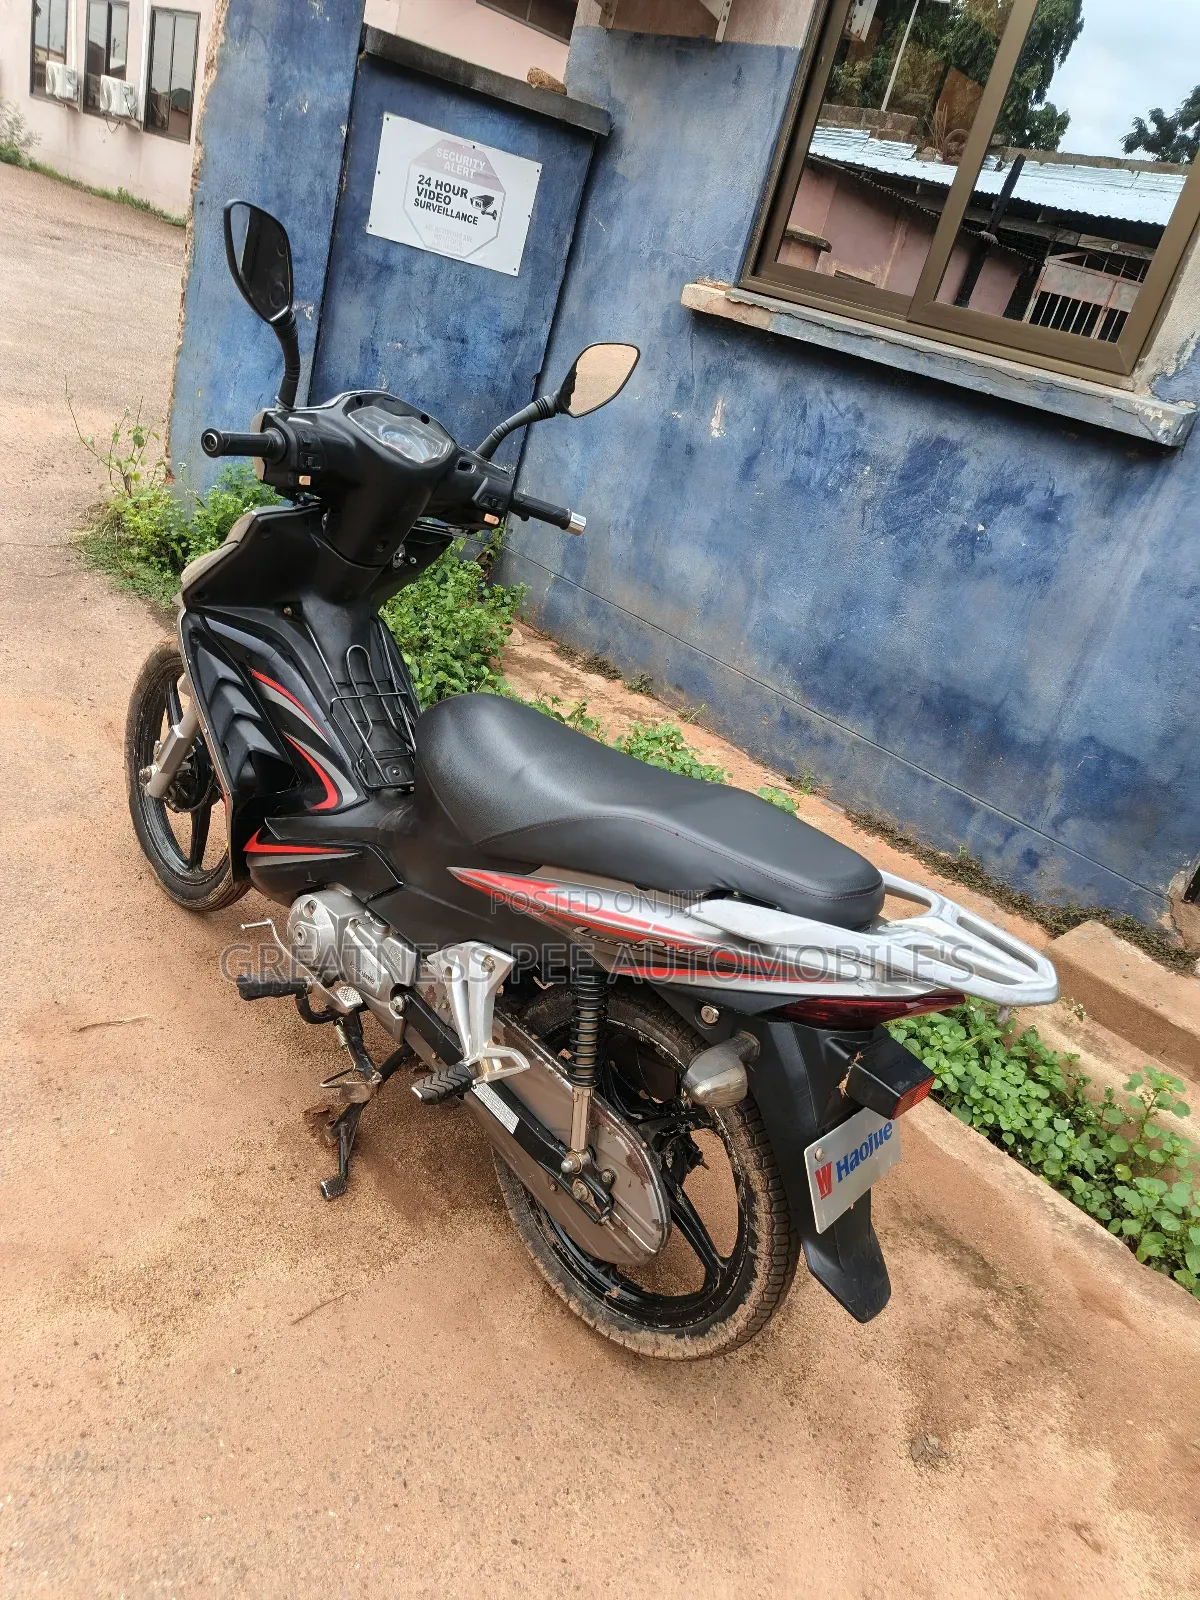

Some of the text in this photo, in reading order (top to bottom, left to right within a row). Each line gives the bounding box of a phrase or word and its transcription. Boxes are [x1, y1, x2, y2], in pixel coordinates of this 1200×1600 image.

[436, 147, 486, 171] SECURITY
[443, 161, 477, 179] ALERT
[416, 185, 452, 206] VIDEO
[417, 174, 469, 199] 24 HOUR
[413, 197, 479, 226] SURVEILLANCE
[835, 1121, 893, 1184] Haojue
